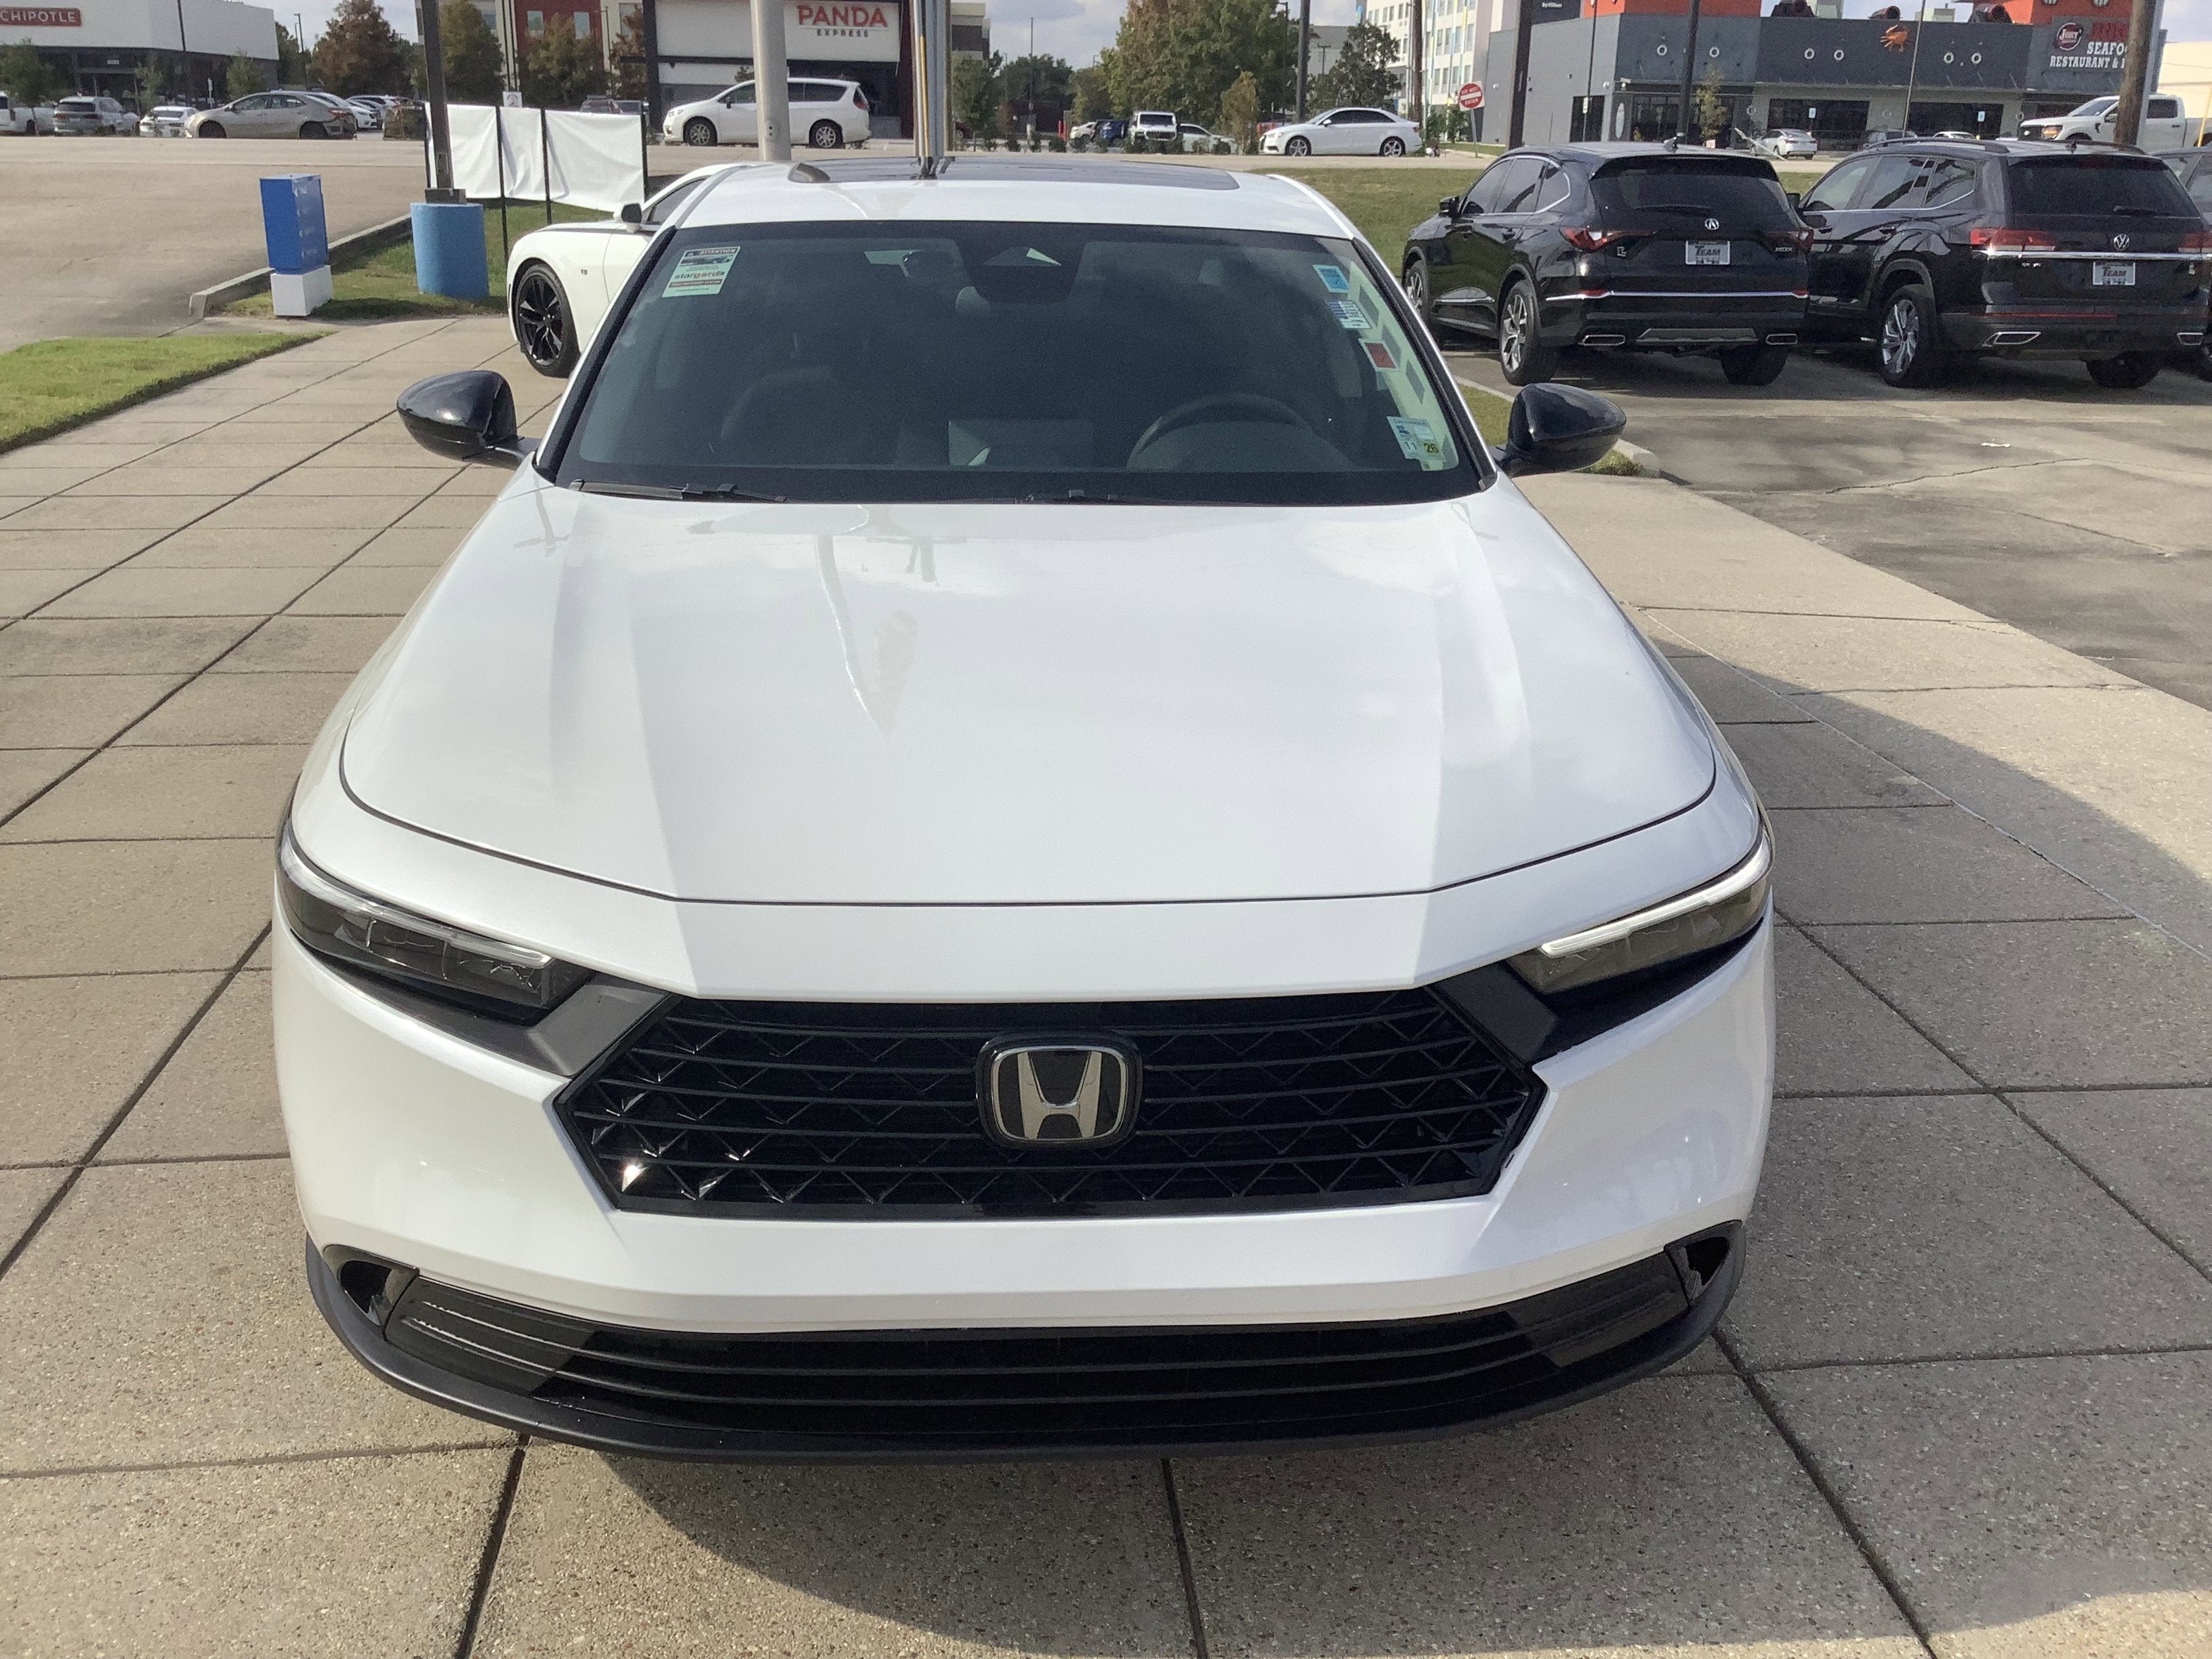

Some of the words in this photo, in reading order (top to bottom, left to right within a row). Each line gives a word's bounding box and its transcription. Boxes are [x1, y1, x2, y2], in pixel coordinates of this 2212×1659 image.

[1, 10, 77, 23] CHIPOTLE
[797, 4, 888, 28] PANDA
[817, 28, 869, 37] EXPRESS
[2049, 56, 2110, 68] RESTAURANT
[1424, 443, 1439, 453] 26
